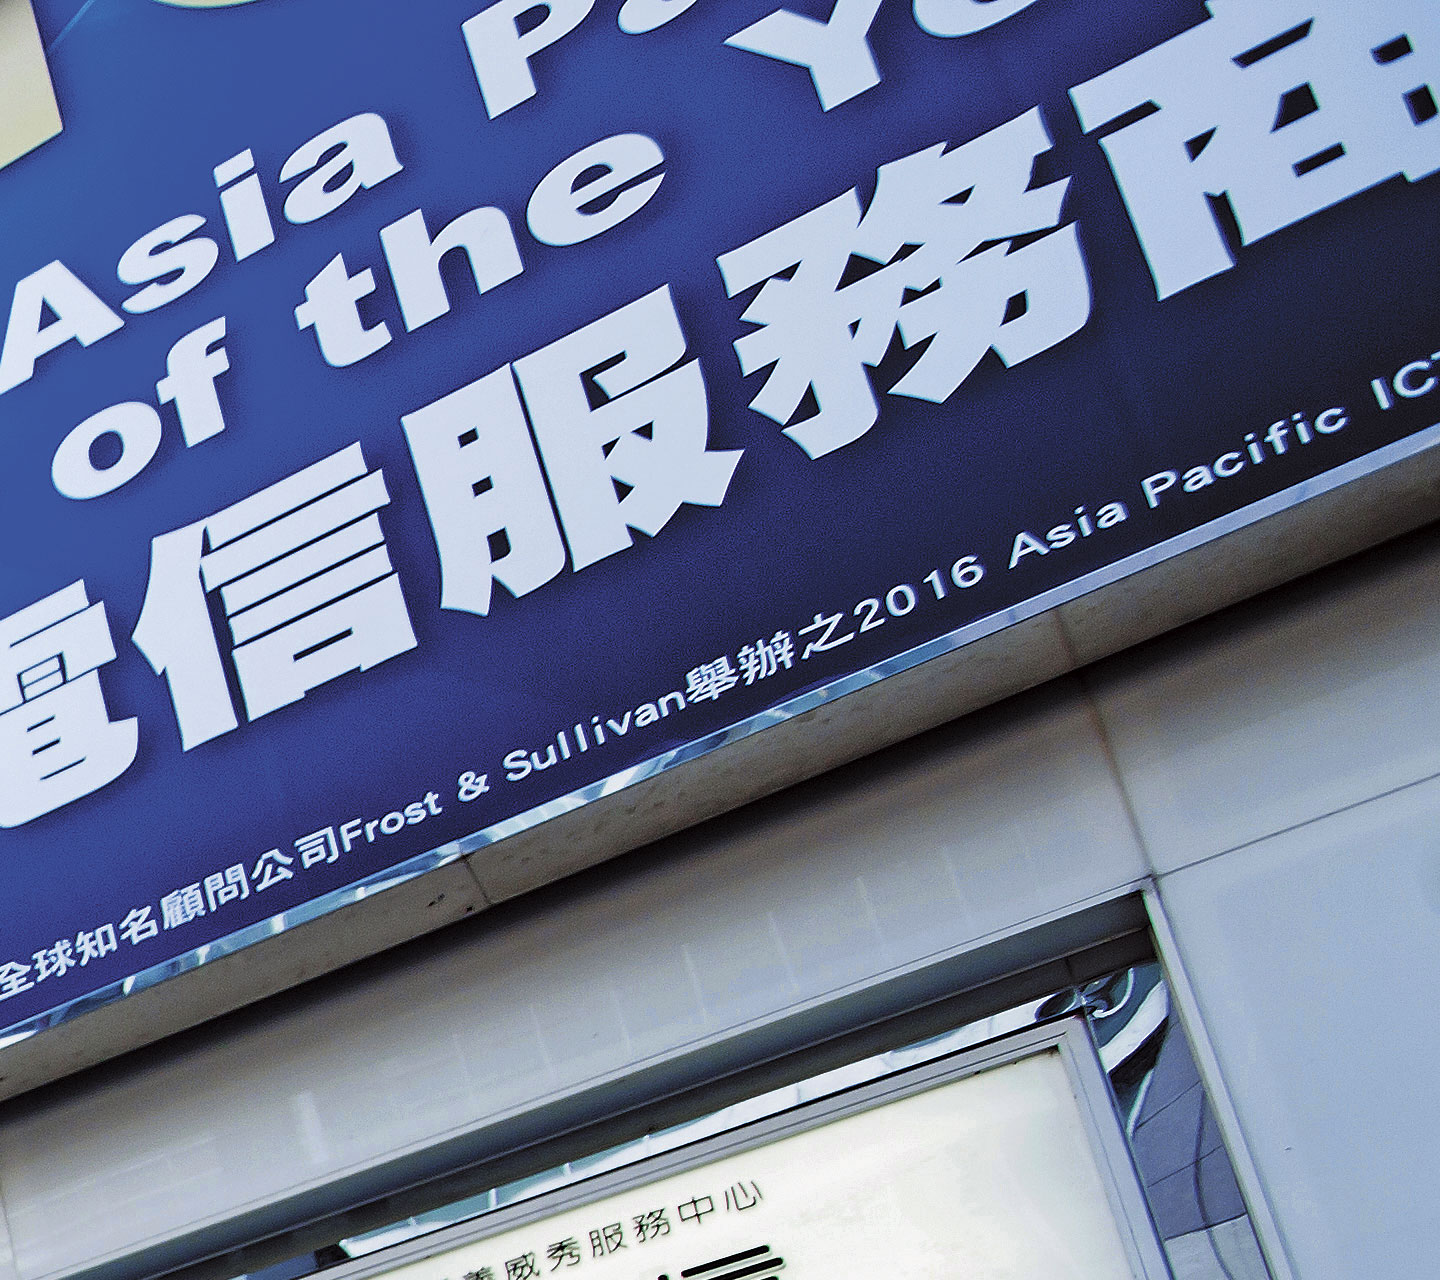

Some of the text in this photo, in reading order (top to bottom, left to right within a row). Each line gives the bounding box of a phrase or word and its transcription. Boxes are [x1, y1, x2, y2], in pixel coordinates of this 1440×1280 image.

[50, 318, 229, 503] of
[295, 130, 668, 370] the
[457, 768, 492, 804] &
[1006, 502, 1130, 571] Asia
[1140, 406, 1351, 510] Pacific
